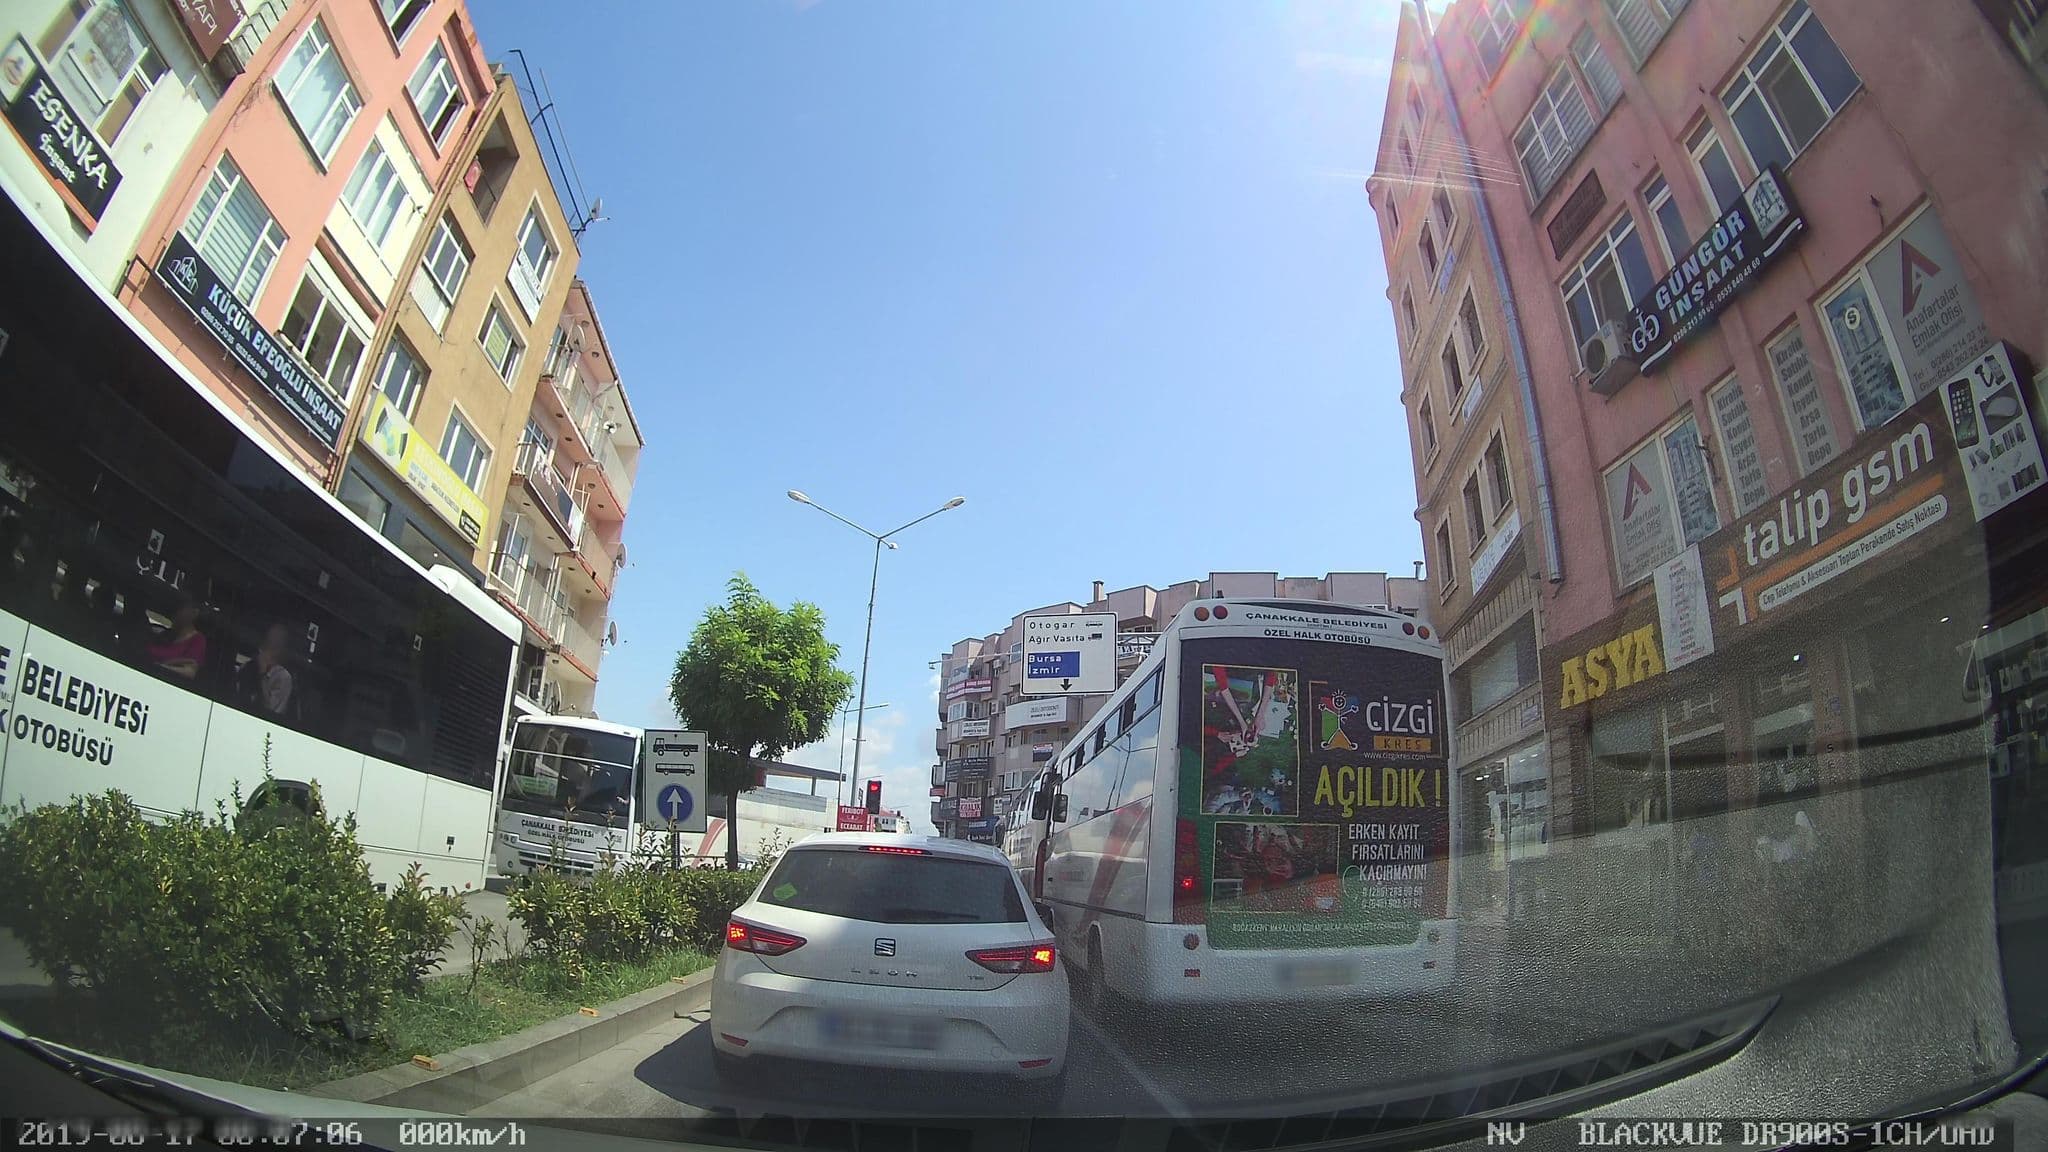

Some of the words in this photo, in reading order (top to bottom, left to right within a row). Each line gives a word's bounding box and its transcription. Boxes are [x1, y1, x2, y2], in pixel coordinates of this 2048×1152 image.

[192, 0, 218, 35] API
[30, 79, 108, 189] ESENKA
[1655, 210, 1745, 310] GÜNGÖR
[1667, 240, 1745, 325] İNŞAAT
[1906, 284, 1960, 334] Anafartalar
[1912, 320, 1941, 348] Emlak
[1941, 301, 1963, 326] Ofisi
[207, 283, 254, 341] KÜÇÜK
[252, 331, 304, 392] EFEOĞLU
[301, 380, 342, 430] İNŞAAT
[1743, 489, 1830, 566] talip
[1842, 422, 1934, 523] gsm
[1029, 621, 1075, 630] Otogar
[1246, 613, 1320, 624] ÇANAKKALE
[1323, 618, 1388, 630] BELEDİYESİ
[1294, 631, 1322, 640] HALK
[1028, 654, 1062, 663] Bursa
[1560, 623, 1667, 709] ASYA
[21, 658, 149, 736] BELEDİYESİ
[14, 714, 114, 766] OTOBÜSÜ
[1313, 765, 1425, 818] AÇILDIK
[1348, 823, 1386, 840] ERKEN
[1389, 823, 1420, 840] KAYIT
[1352, 844, 1424, 860] FIRSATLARINI
